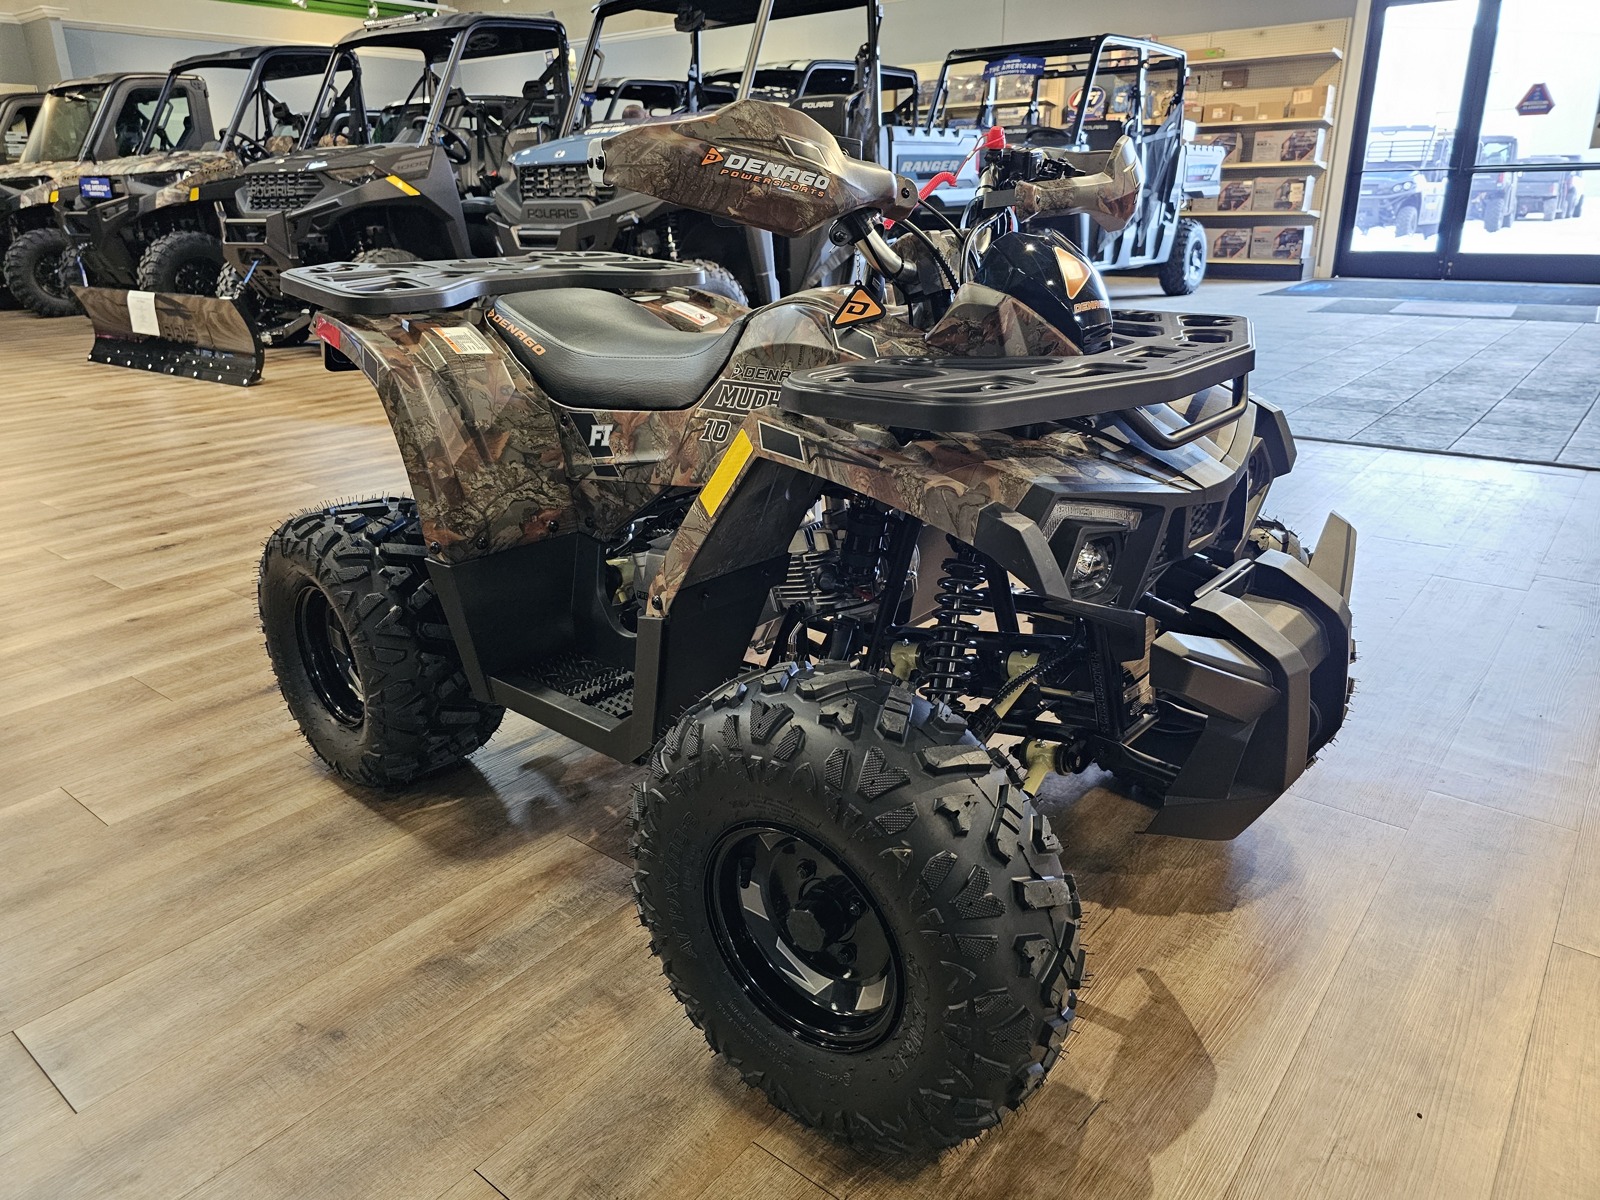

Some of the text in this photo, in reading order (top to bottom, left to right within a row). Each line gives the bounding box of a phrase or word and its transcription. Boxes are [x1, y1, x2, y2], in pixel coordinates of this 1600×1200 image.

[989, 63, 1037, 73] THE AMERICAN
[802, 100, 834, 109] POLARIS
[516, 126, 538, 135] POLARIS
[723, 153, 831, 190] DENAGO
[901, 160, 959, 173] RANGER
[720, 168, 826, 198] POWERSPORTS
[250, 185, 296, 197] POLARIS
[527, 208, 579, 219] POLARIS
[492, 314, 546, 356] DENAGO
[588, 424, 614, 447] FI
